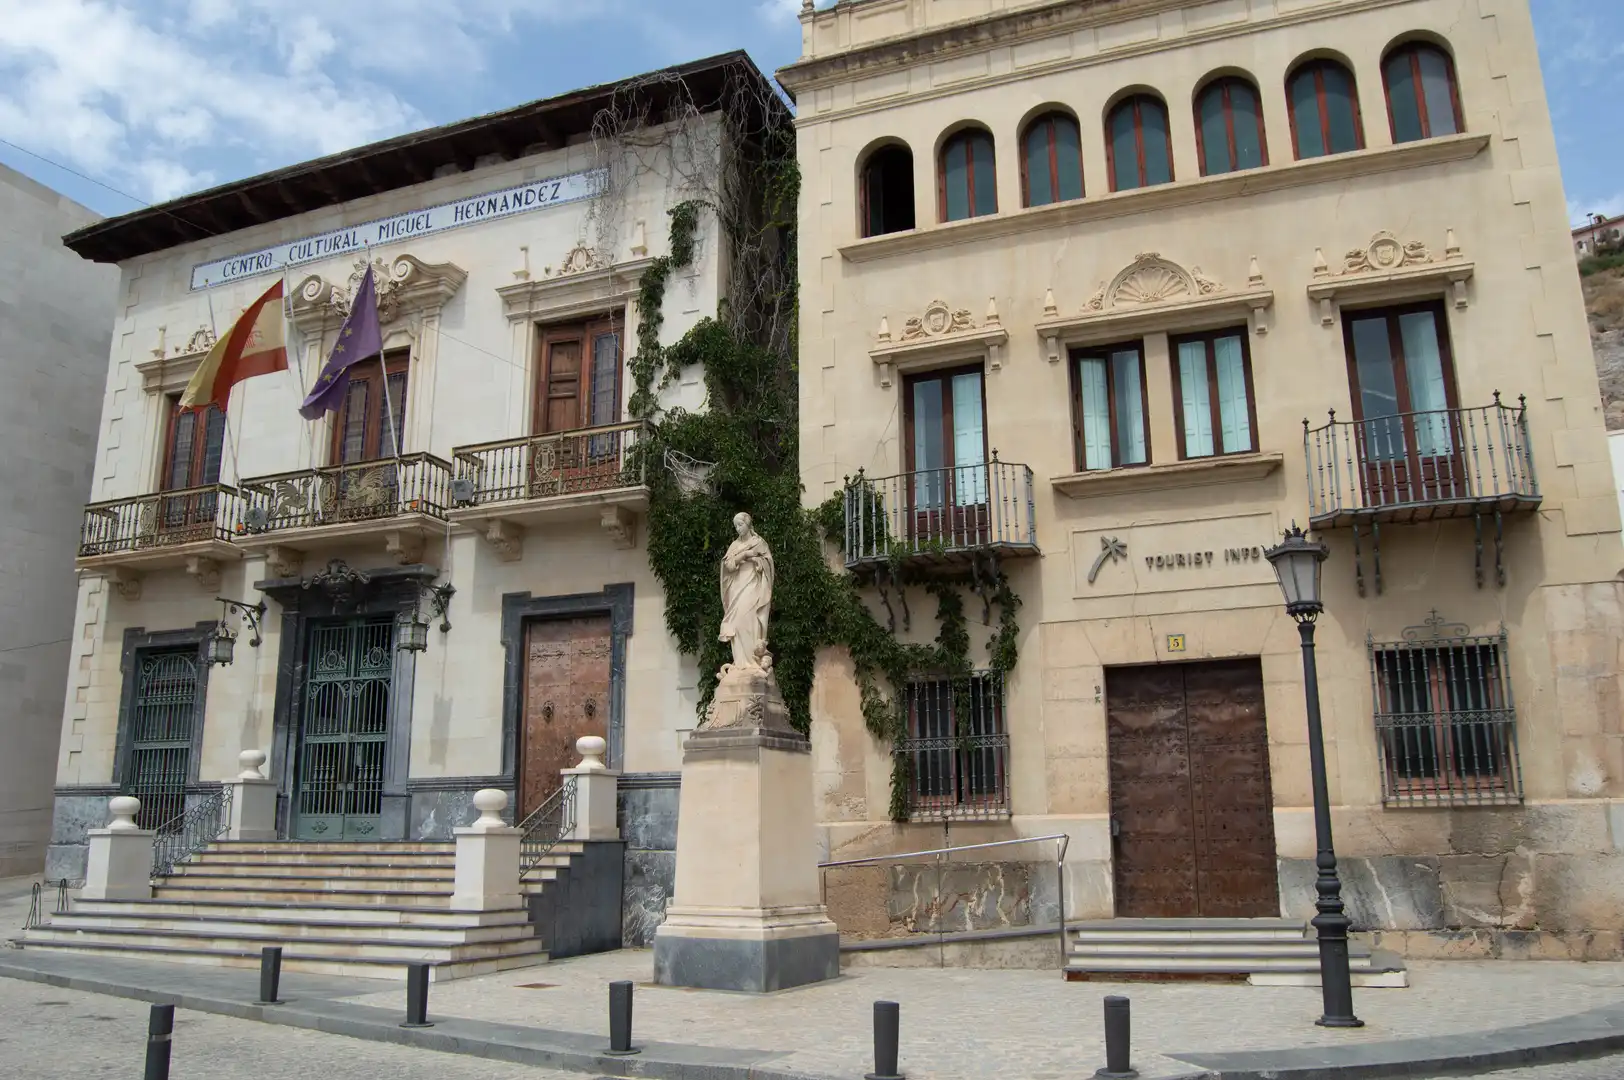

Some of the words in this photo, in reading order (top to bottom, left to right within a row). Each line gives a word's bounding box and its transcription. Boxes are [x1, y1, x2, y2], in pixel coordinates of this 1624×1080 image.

[222, 252, 273, 278] CENTRO
[289, 230, 360, 262] CULTURAL
[378, 214, 433, 241] MIGUEL
[454, 182, 562, 223] HERNANDEZ
[1145, 550, 1214, 571] TOURIST
[1224, 546, 1260, 564] INFO
[1172, 638, 1180, 648] 5
